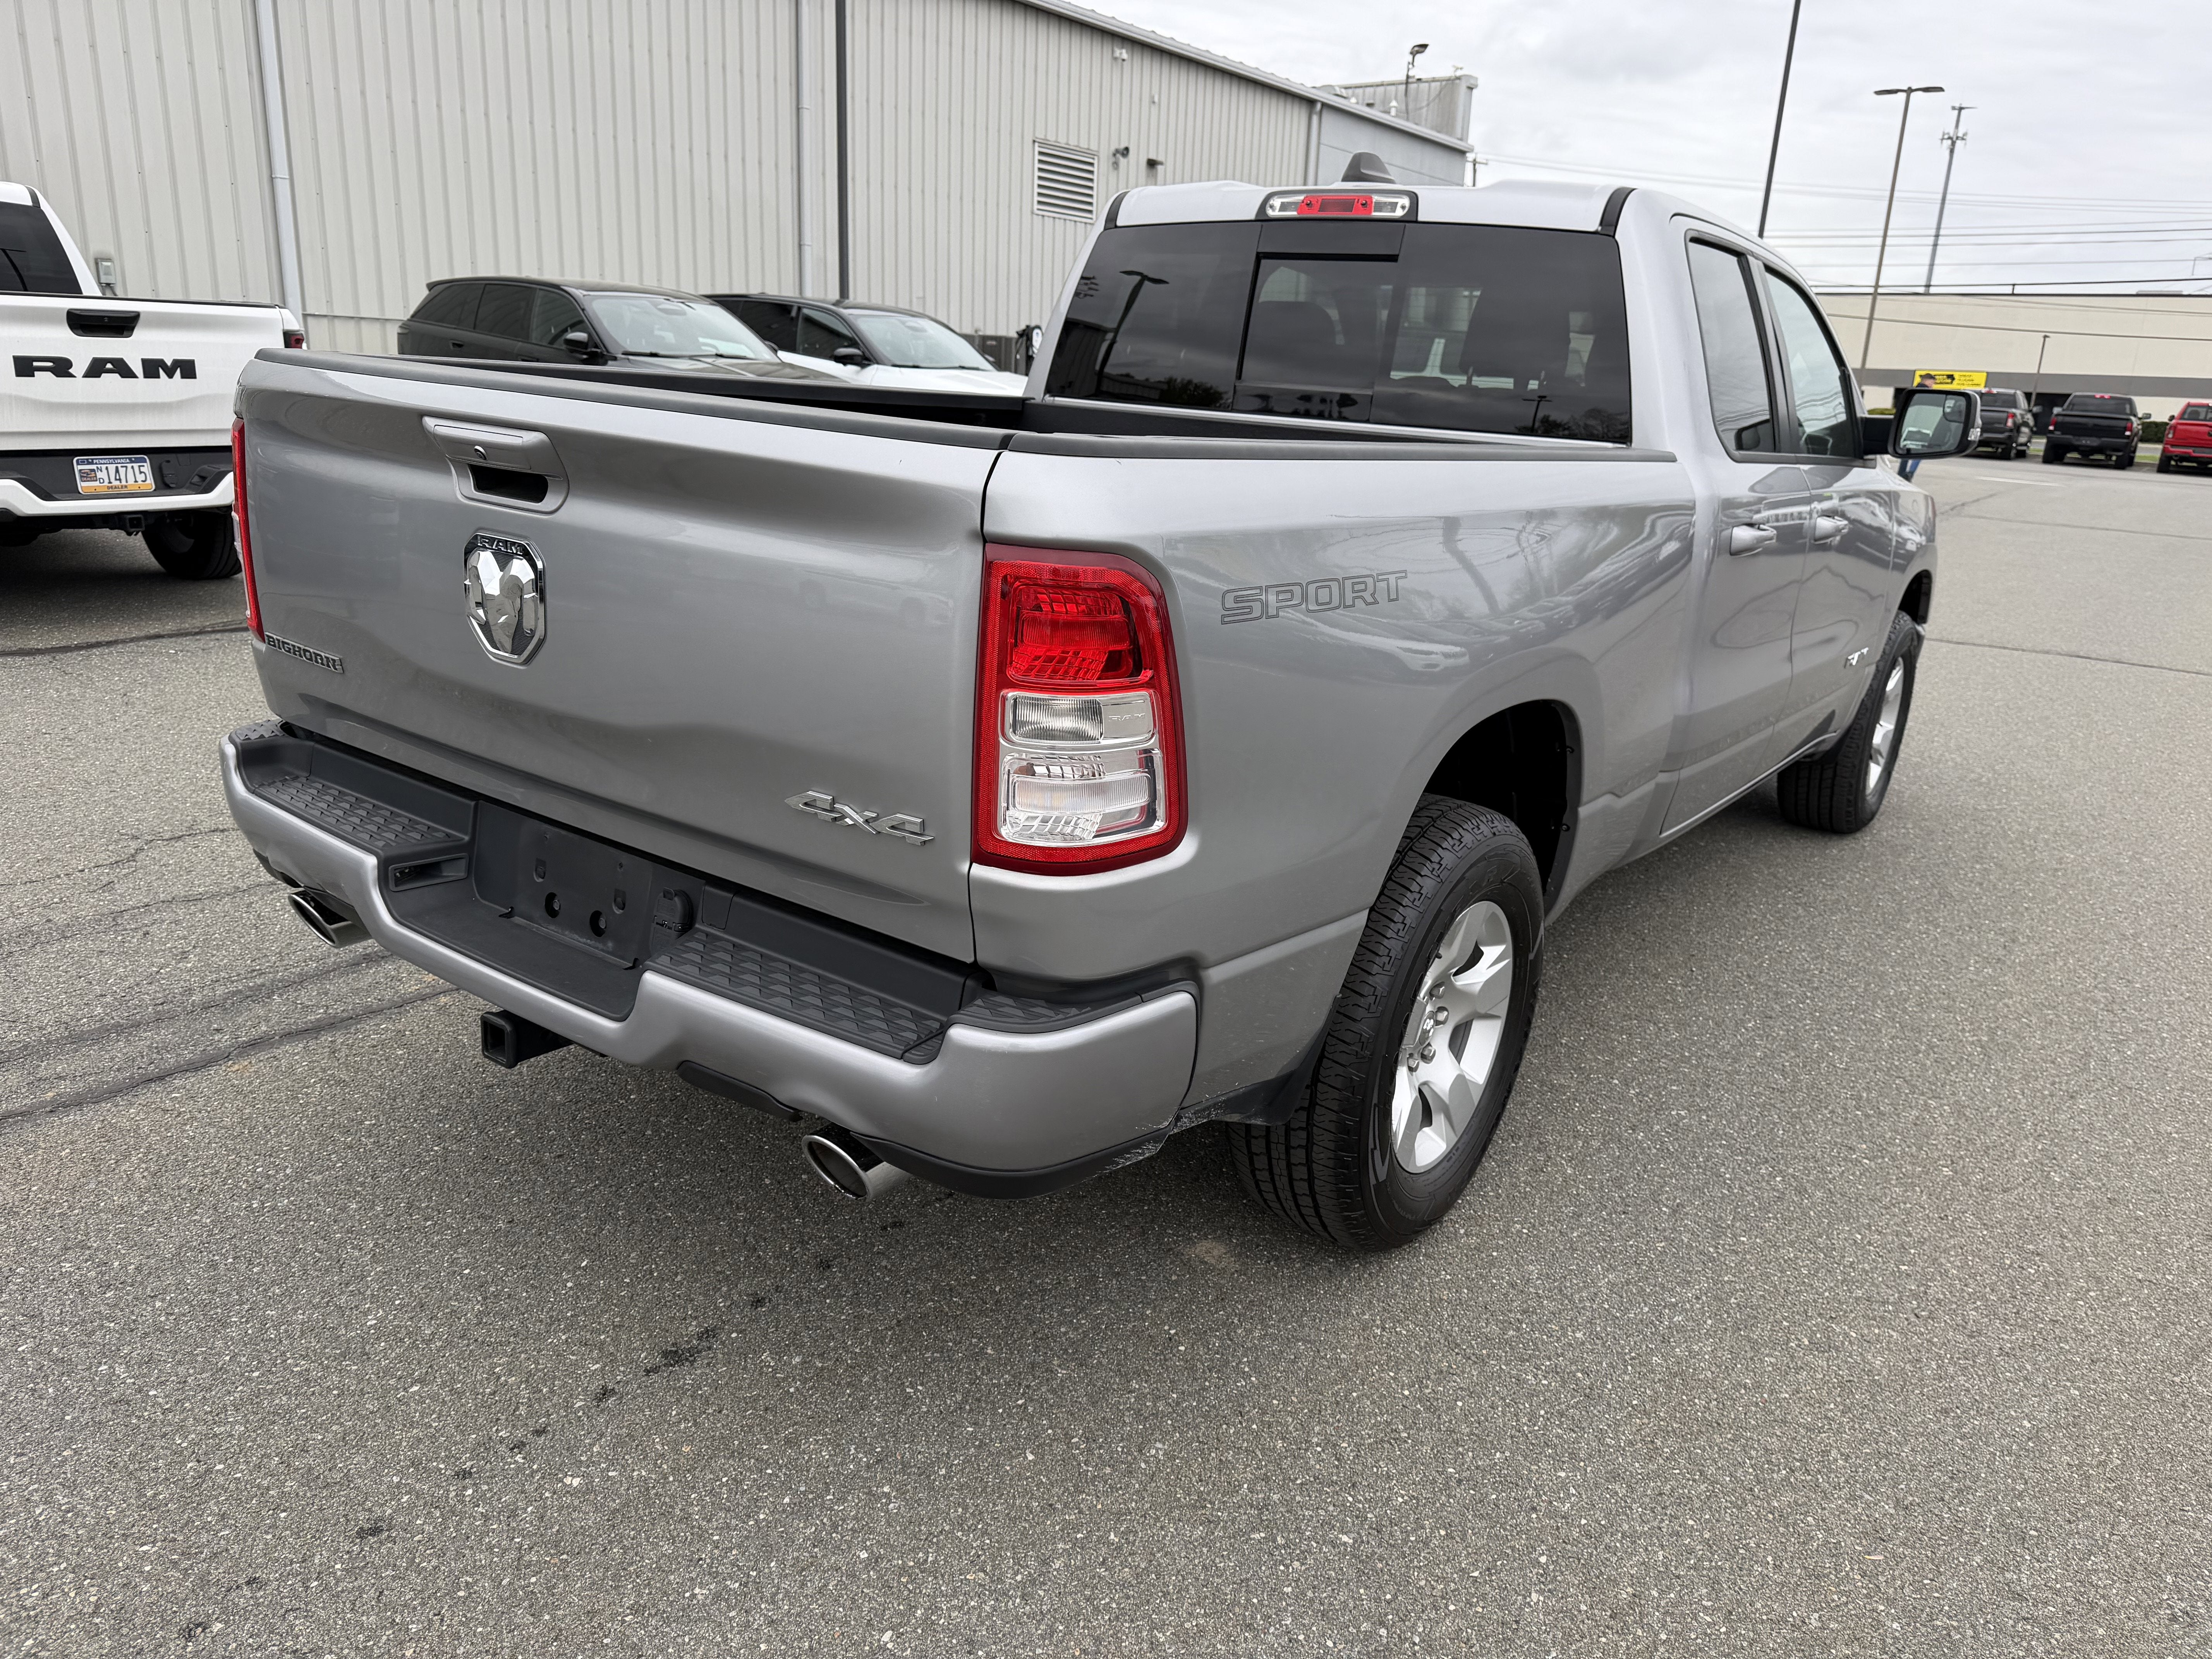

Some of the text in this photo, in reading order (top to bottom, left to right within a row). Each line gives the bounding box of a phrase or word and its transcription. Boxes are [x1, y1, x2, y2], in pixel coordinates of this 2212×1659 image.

[12, 355, 197, 379] RAM
[105, 465, 147, 484] 14715
[477, 535, 524, 555] RAM
[1221, 570, 1408, 625] SPORT
[264, 632, 344, 673] BIGHORN
